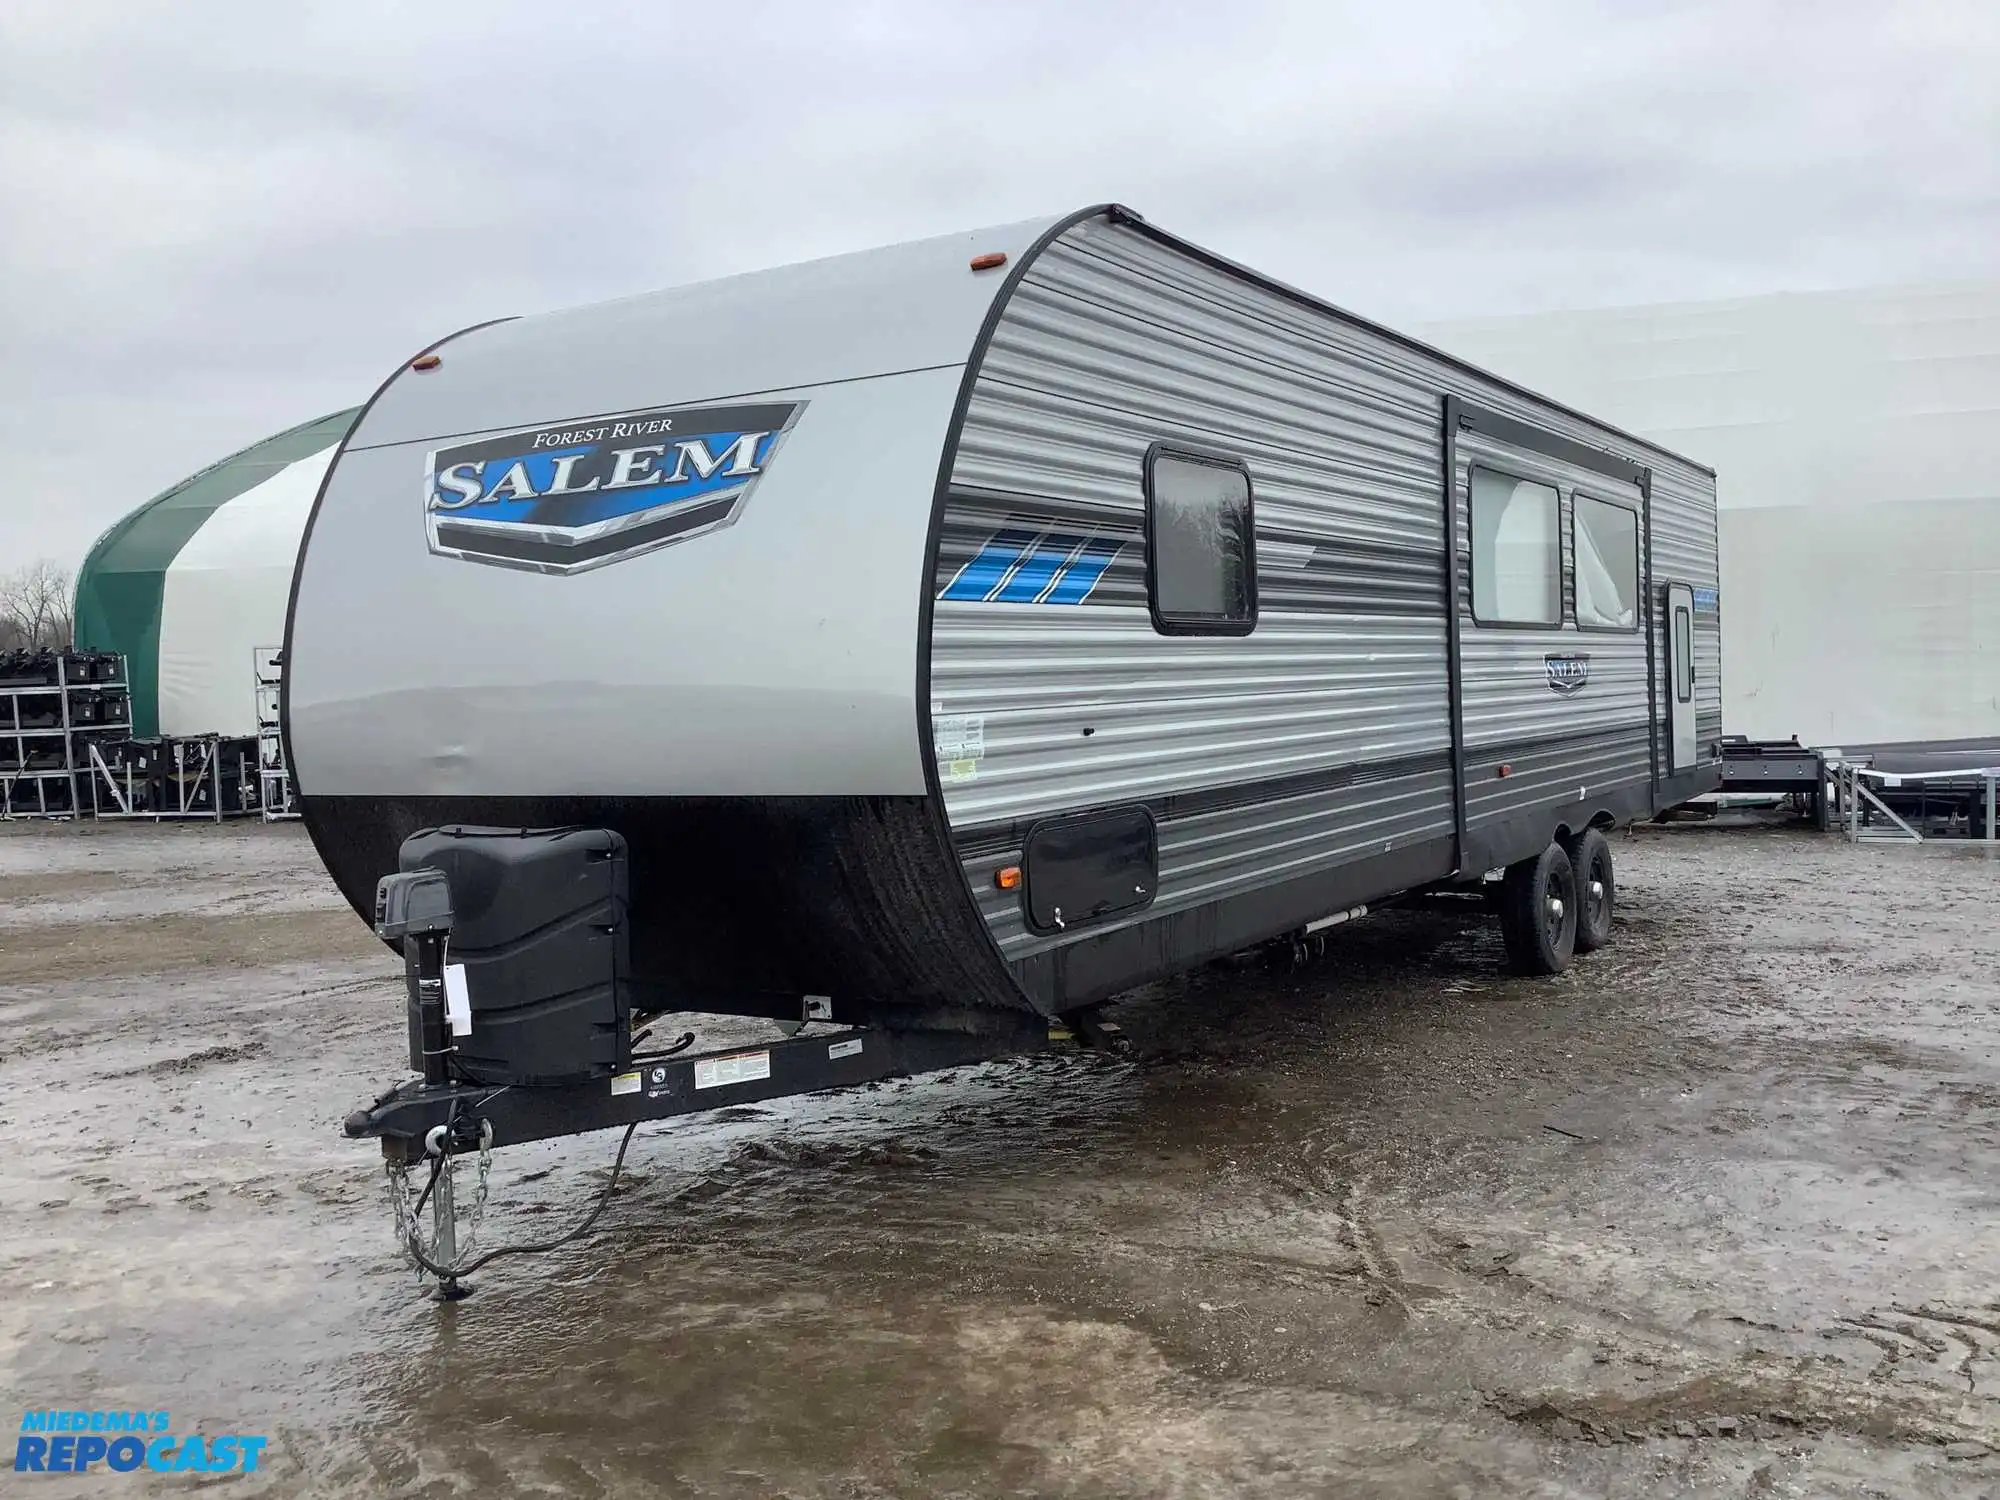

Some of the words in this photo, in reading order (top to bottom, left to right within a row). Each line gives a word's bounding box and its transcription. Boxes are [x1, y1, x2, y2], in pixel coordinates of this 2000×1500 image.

[532, 427, 608, 448] FOREST
[609, 418, 672, 438] RIVER
[430, 431, 769, 510] SALEM
[1547, 661, 1587, 677] SALEM
